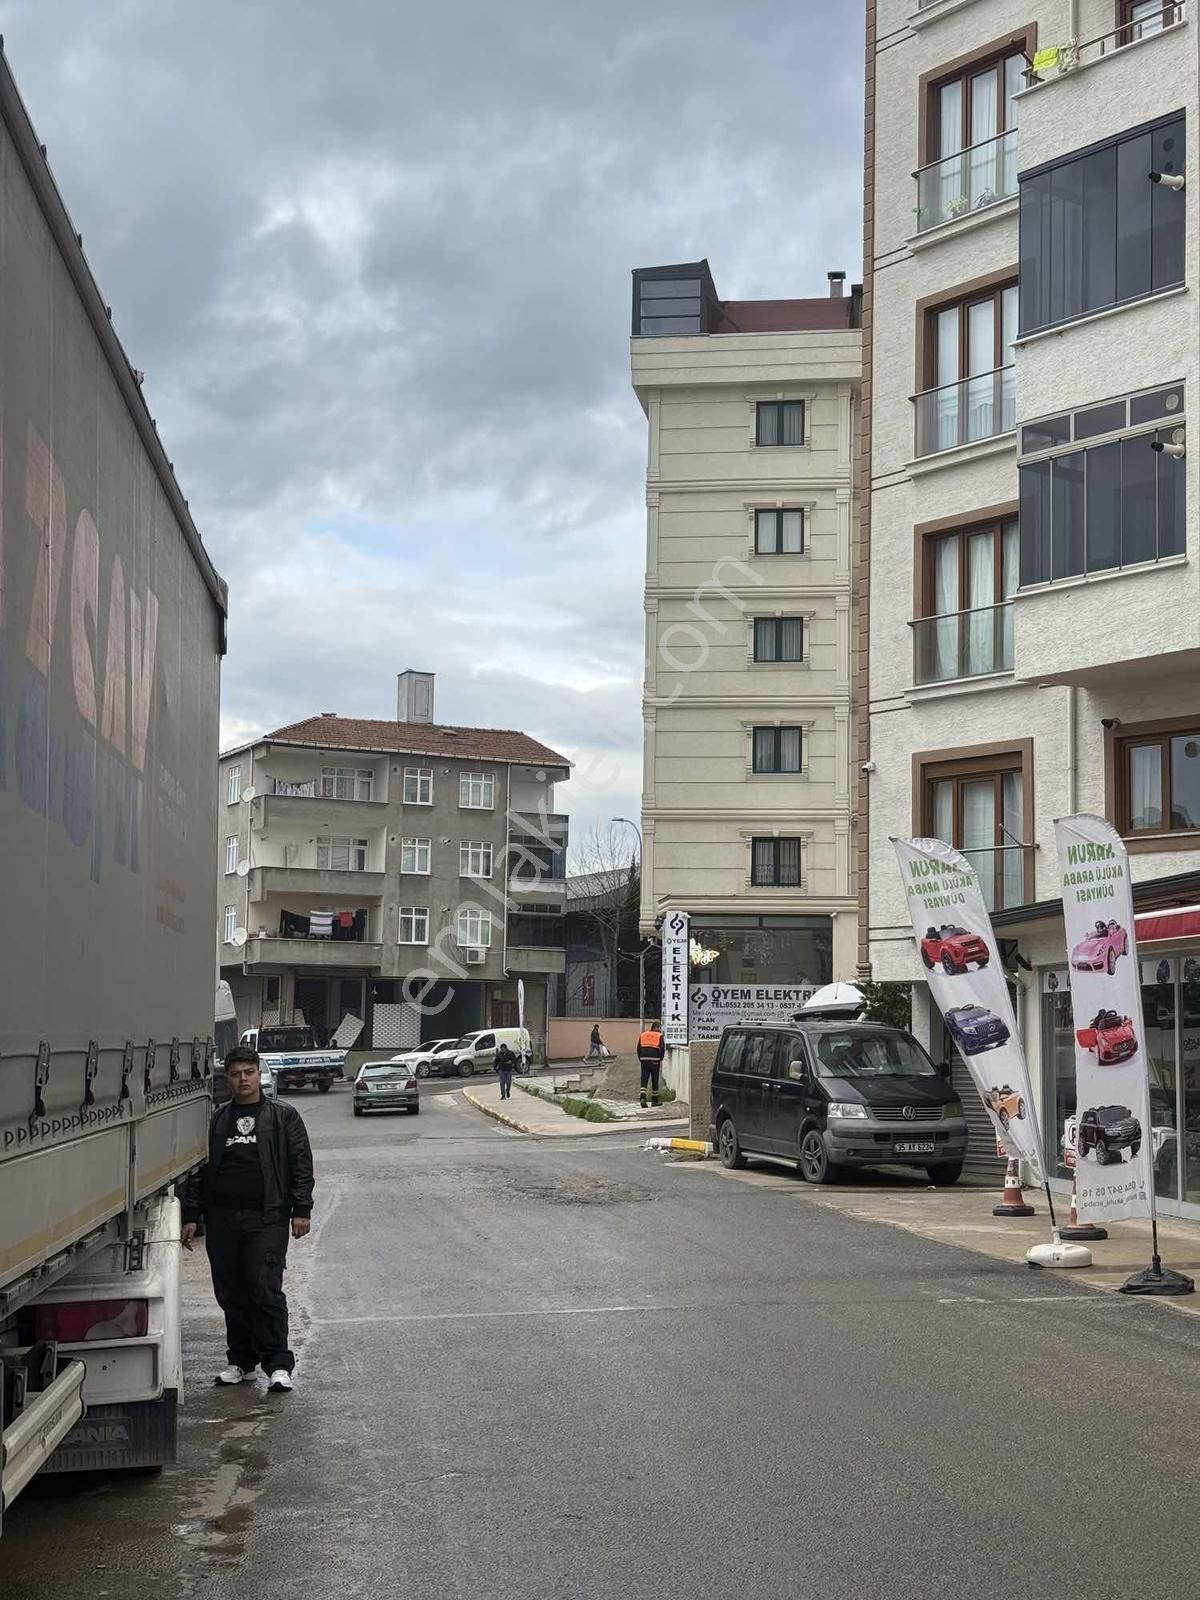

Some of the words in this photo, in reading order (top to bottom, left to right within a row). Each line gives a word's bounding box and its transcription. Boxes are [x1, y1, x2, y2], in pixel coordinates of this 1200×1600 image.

[671, 947, 681, 1021] ELEKTRİK
[711, 986, 751, 1001] ÖYEM
[756, 987, 816, 1001] ELEKTRİ
[225, 1135, 257, 1147] SCAN
